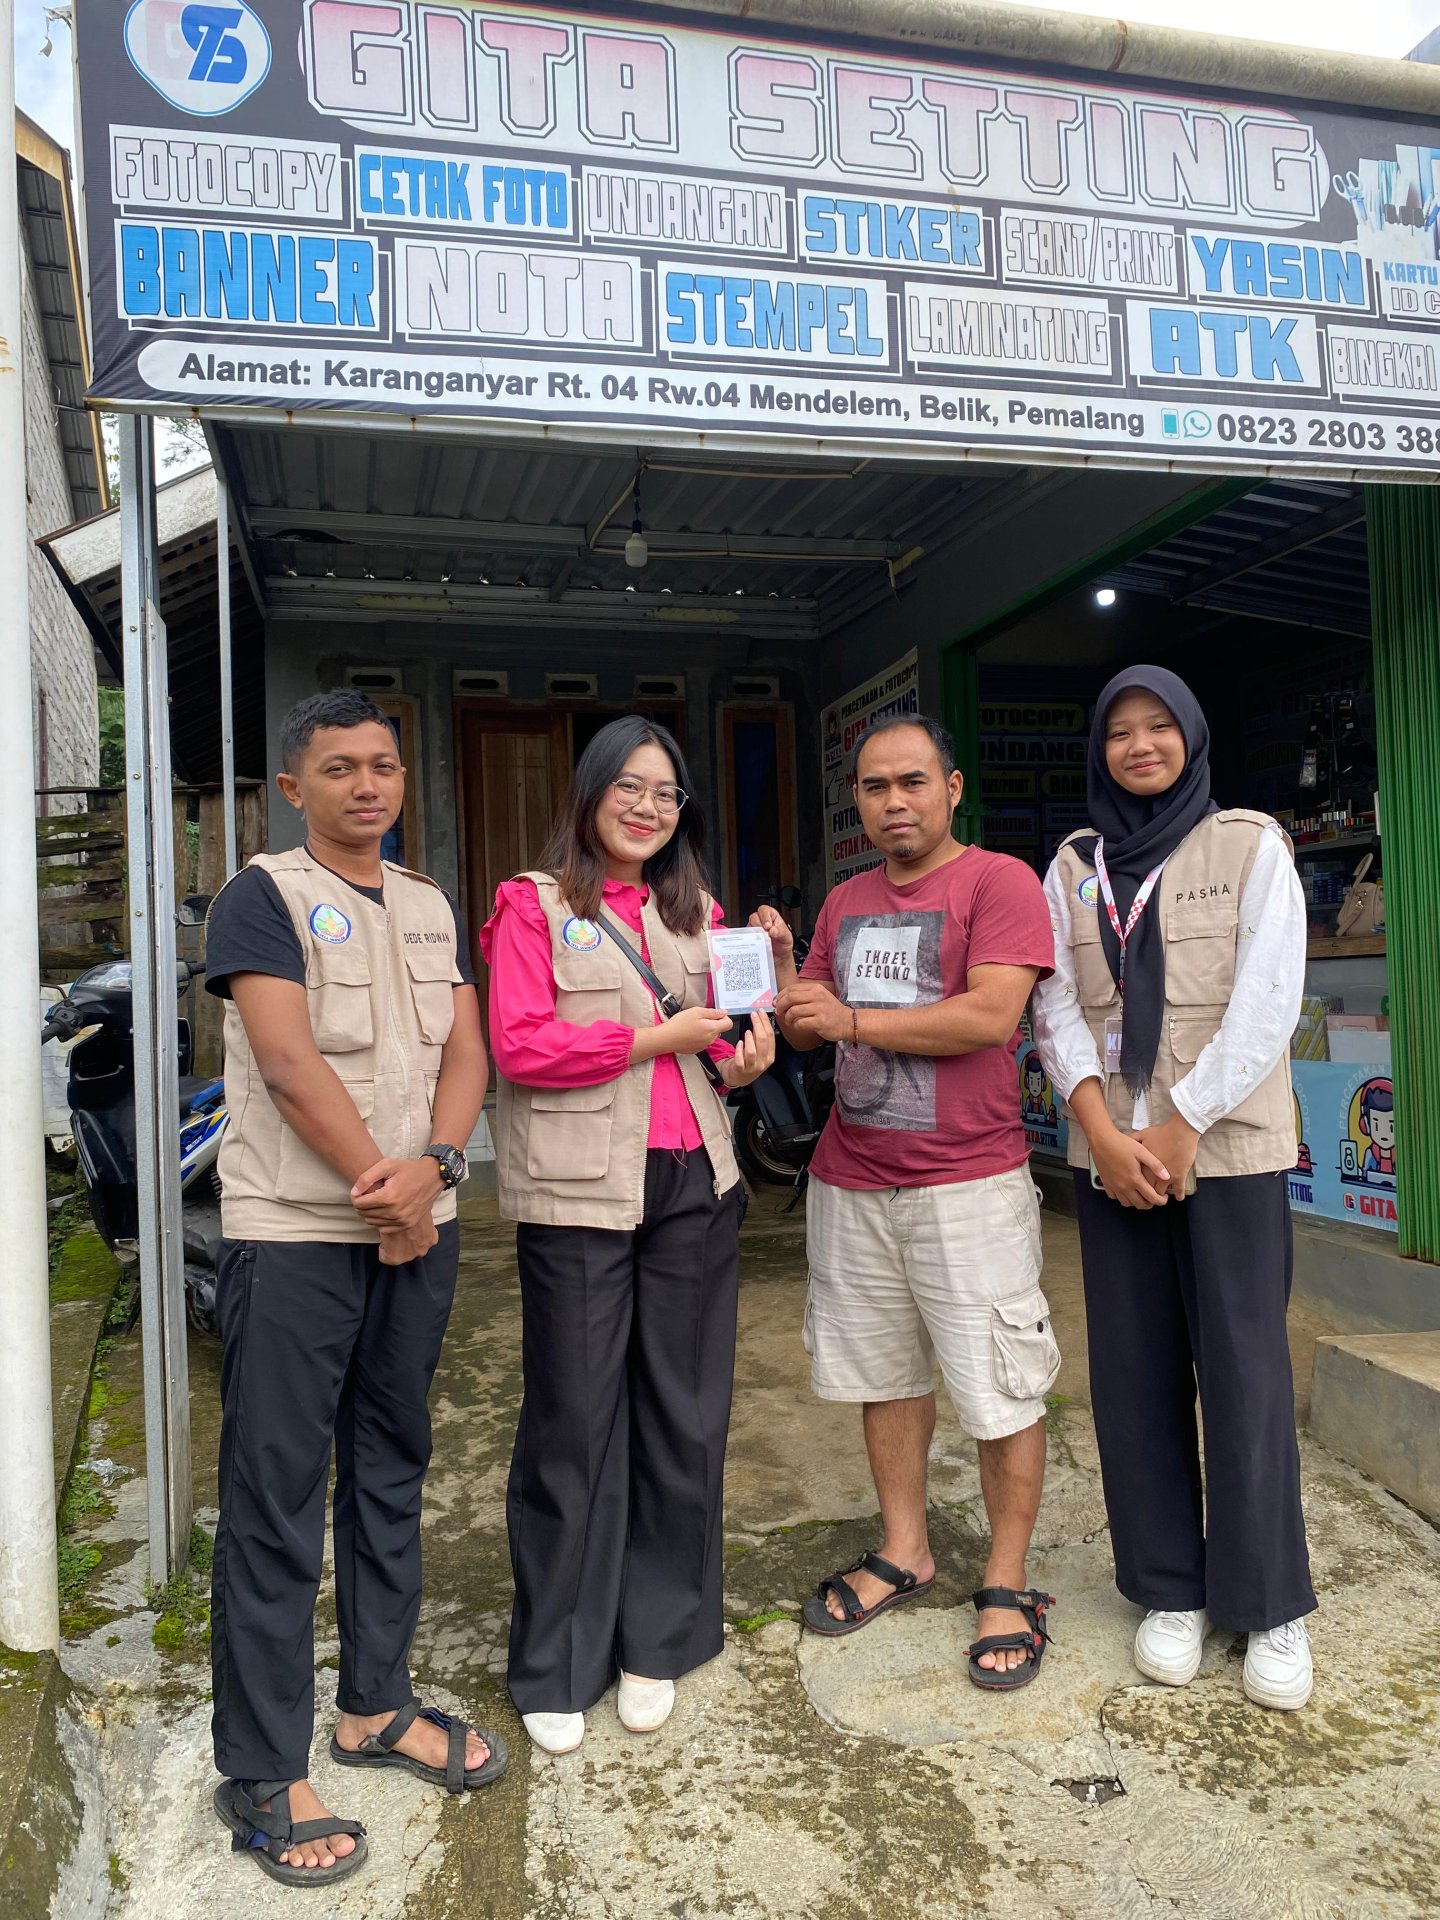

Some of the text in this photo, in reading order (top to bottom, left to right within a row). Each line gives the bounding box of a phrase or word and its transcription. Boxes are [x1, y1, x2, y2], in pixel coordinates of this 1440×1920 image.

[301, 0, 1320, 223] GITA SETTING
[114, 137, 337, 213] FOTOCOPY
[358, 153, 569, 230] CETAK FOTO
[587, 173, 783, 250] UNDANGAN
[804, 195, 982, 267] STIKER
[121, 224, 377, 329] BANNER
[1004, 216, 1173, 286] SCANT/PRINT
[1191, 235, 1365, 306] YASIN
[1383, 261, 1438, 286] KARTU
[404, 246, 636, 342] NOTA
[666, 272, 885, 357] STEMPEL
[1391, 287, 1419, 312] ID
[910, 298, 1109, 367] LAMINATING
[1150, 307, 1304, 383] ATK
[1331, 337, 1438, 392] BINGKAI
[178, 352, 1145, 437] Alamat: Karanganyar Rt. 04 Rw.04 Mendelem, Belik, Pemalang
[1217, 413, 1297, 445] 0823
[1307, 418, 1386, 450] 2803
[1176, 883, 1231, 904] PASHA
[404, 932, 451, 944] DEDE RIDWAN
[856, 964, 911, 981] SECOND
[865, 950, 907, 966] THREE
[1360, 1194, 1398, 1221] GITA
